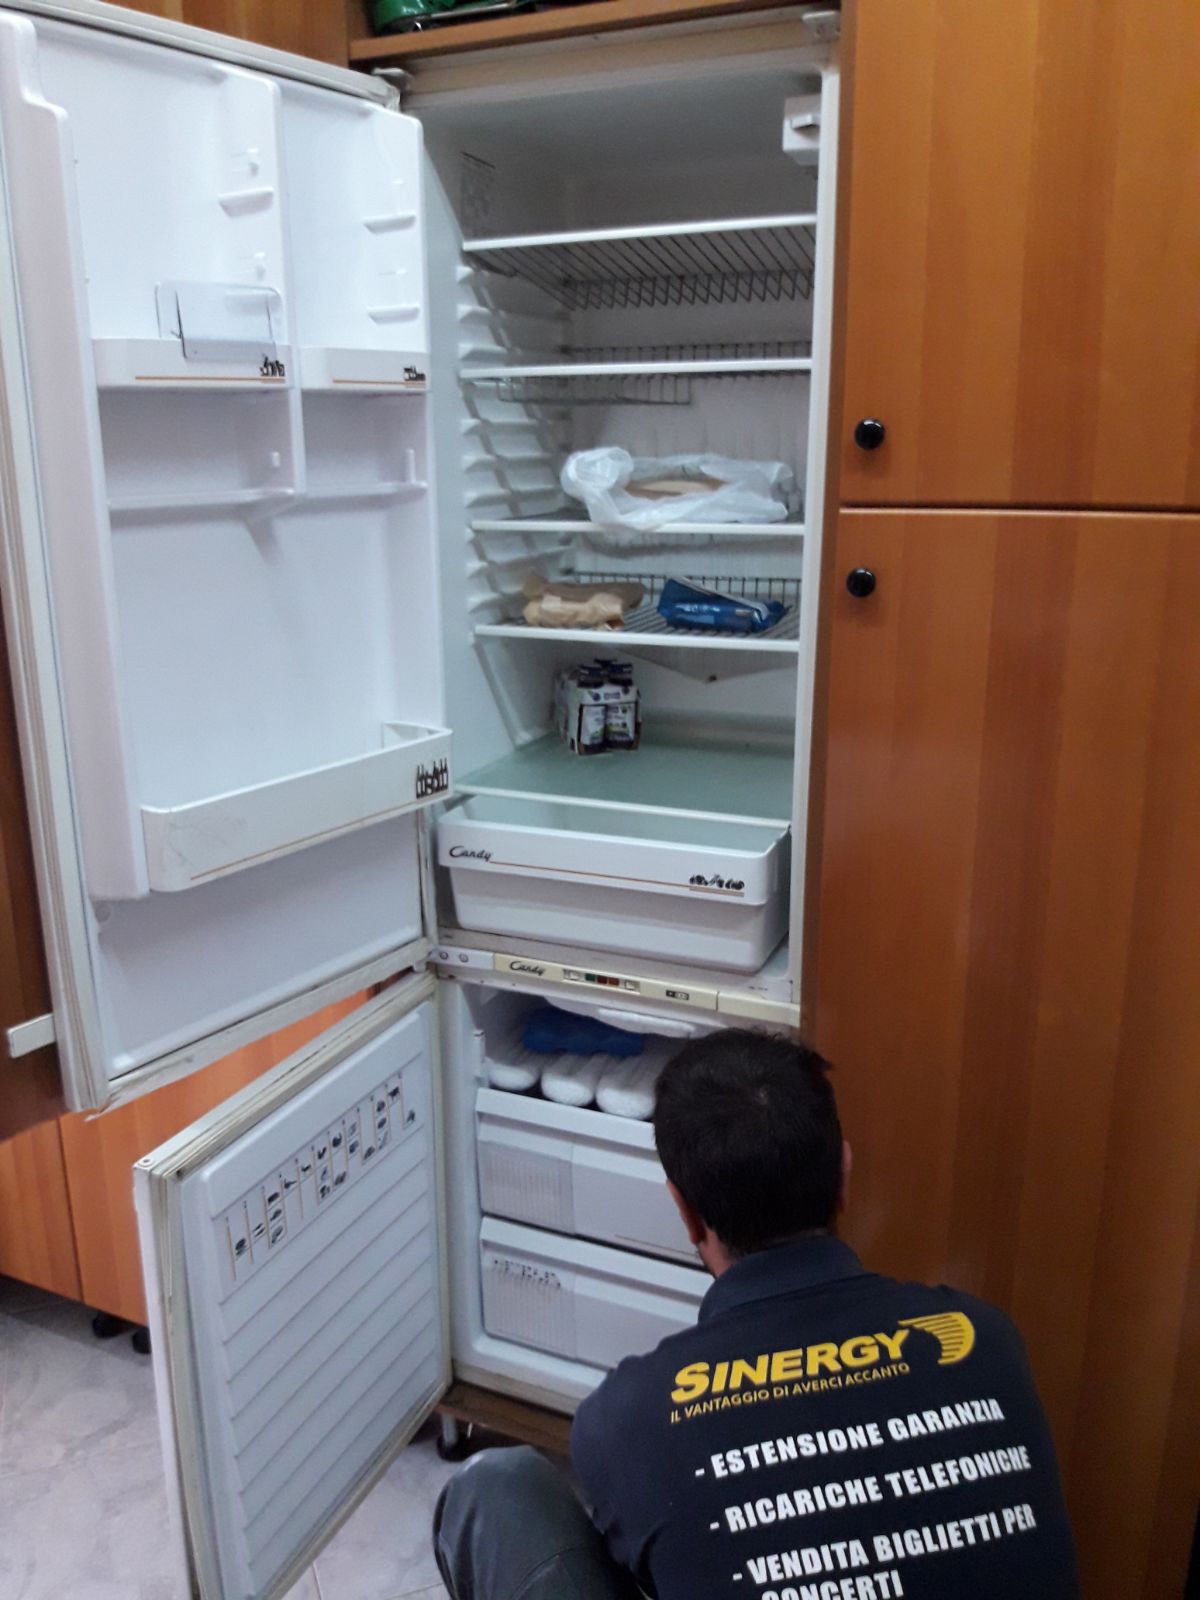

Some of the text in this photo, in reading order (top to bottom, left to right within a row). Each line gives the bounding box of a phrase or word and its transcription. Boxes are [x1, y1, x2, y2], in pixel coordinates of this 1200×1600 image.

[449, 845, 491, 861] Candy
[509, 960, 545, 976] Candy
[670, 1329, 910, 1404] SINERGY
[670, 1362, 911, 1424] IL VANTAGGIO DI AVERCI ACCANTO
[710, 1422, 884, 1479] ESTENSIONE
[887, 1398, 1005, 1441] GARANZIA
[724, 1475, 884, 1533] RICARICHE
[884, 1445, 1031, 1498] TELEFONICHE
[746, 1539, 870, 1585] VENDITA
[872, 1511, 1002, 1563] BIGLIETTI
[1001, 1503, 1037, 1534] PER
